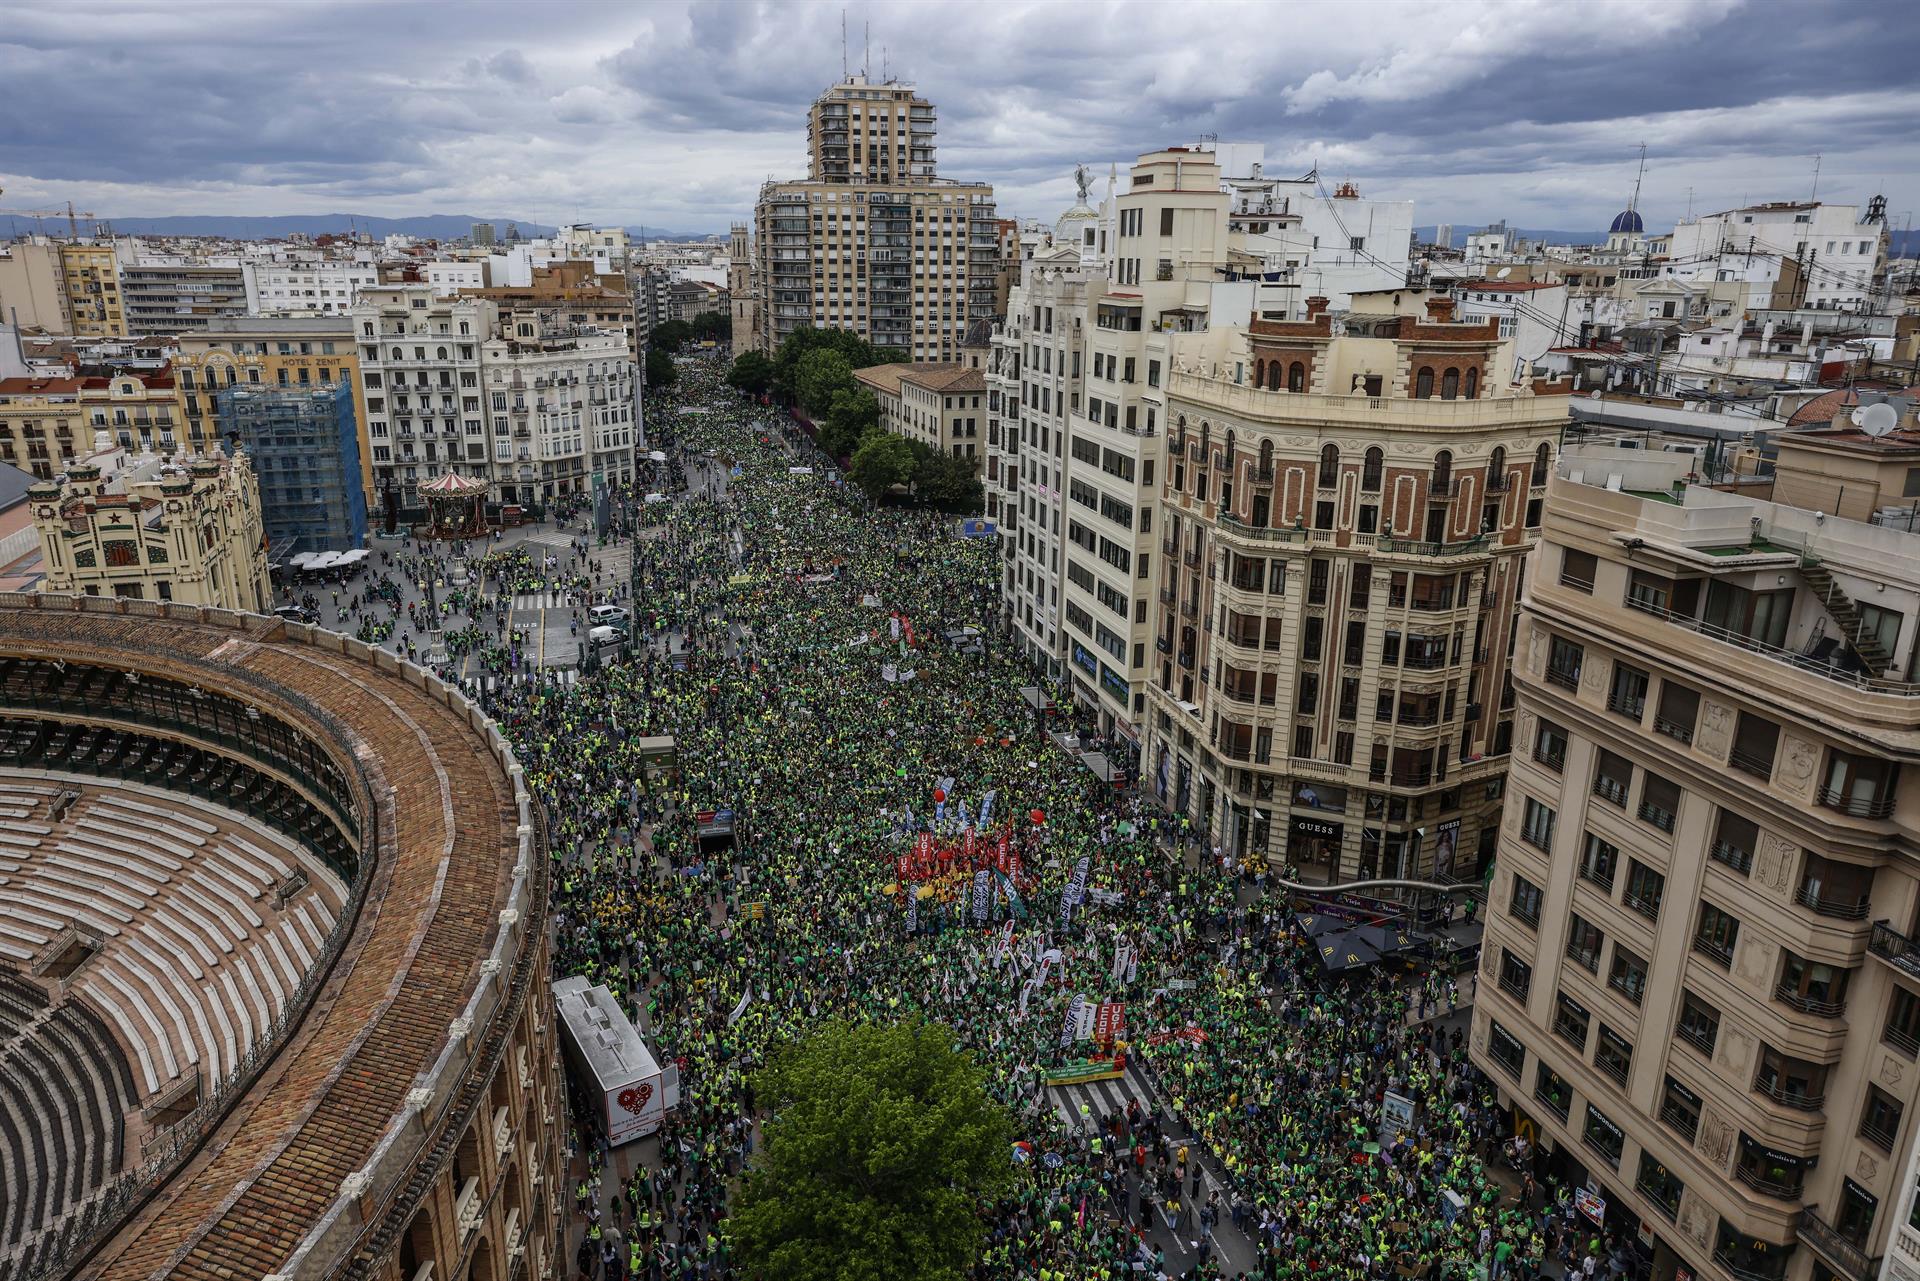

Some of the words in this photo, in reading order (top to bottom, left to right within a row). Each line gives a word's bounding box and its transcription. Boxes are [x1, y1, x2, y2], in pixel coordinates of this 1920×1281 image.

[282, 358, 312, 366] HOTEL
[316, 358, 341, 366] ZENIT
[1298, 822, 1334, 835] GUESS
[1440, 821, 1461, 831] GUESS
[921, 834, 929, 857] UGT
[965, 828, 974, 851] UGT
[900, 857, 908, 873] UG
[1073, 872, 1084, 893] CSIF
[1060, 899, 1071, 919] CSIF
[1064, 1011, 1078, 1035] CSIF
[1081, 1010, 1091, 1035] STEPV
[1098, 1006, 1109, 1034] CCOO
[1111, 1005, 1121, 1030] UGT
[1494, 1023, 1522, 1050] McDonald's
[1588, 1106, 1623, 1138] McDonald's
